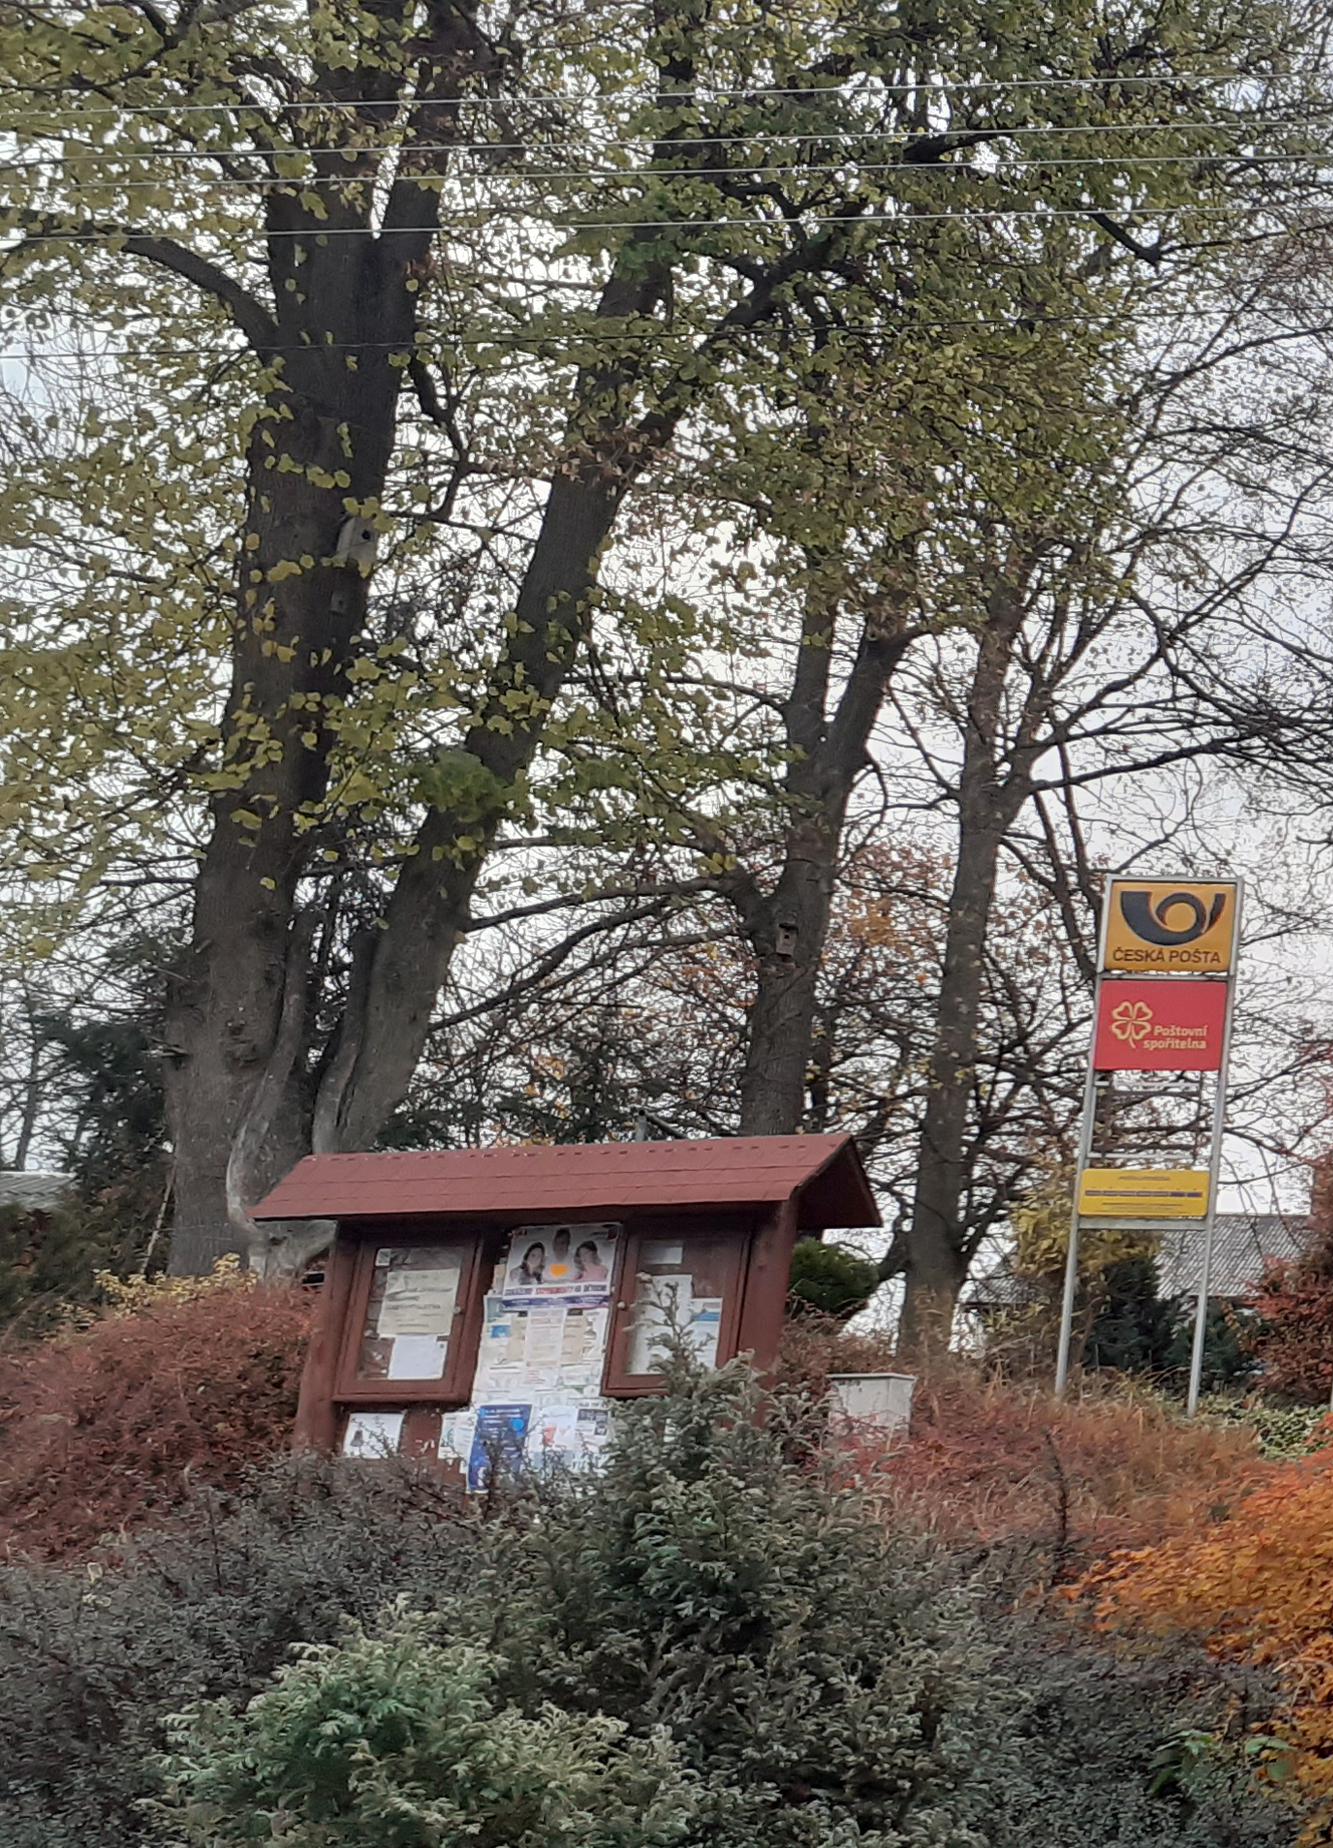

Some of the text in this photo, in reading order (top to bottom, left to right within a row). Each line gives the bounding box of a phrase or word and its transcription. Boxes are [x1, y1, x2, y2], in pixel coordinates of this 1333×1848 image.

[1113, 947, 1221, 963] ČESKÁ POŠTA
[1153, 1024, 1208, 1037] Poštovní
[1143, 1037, 1207, 1051] spořitelna
